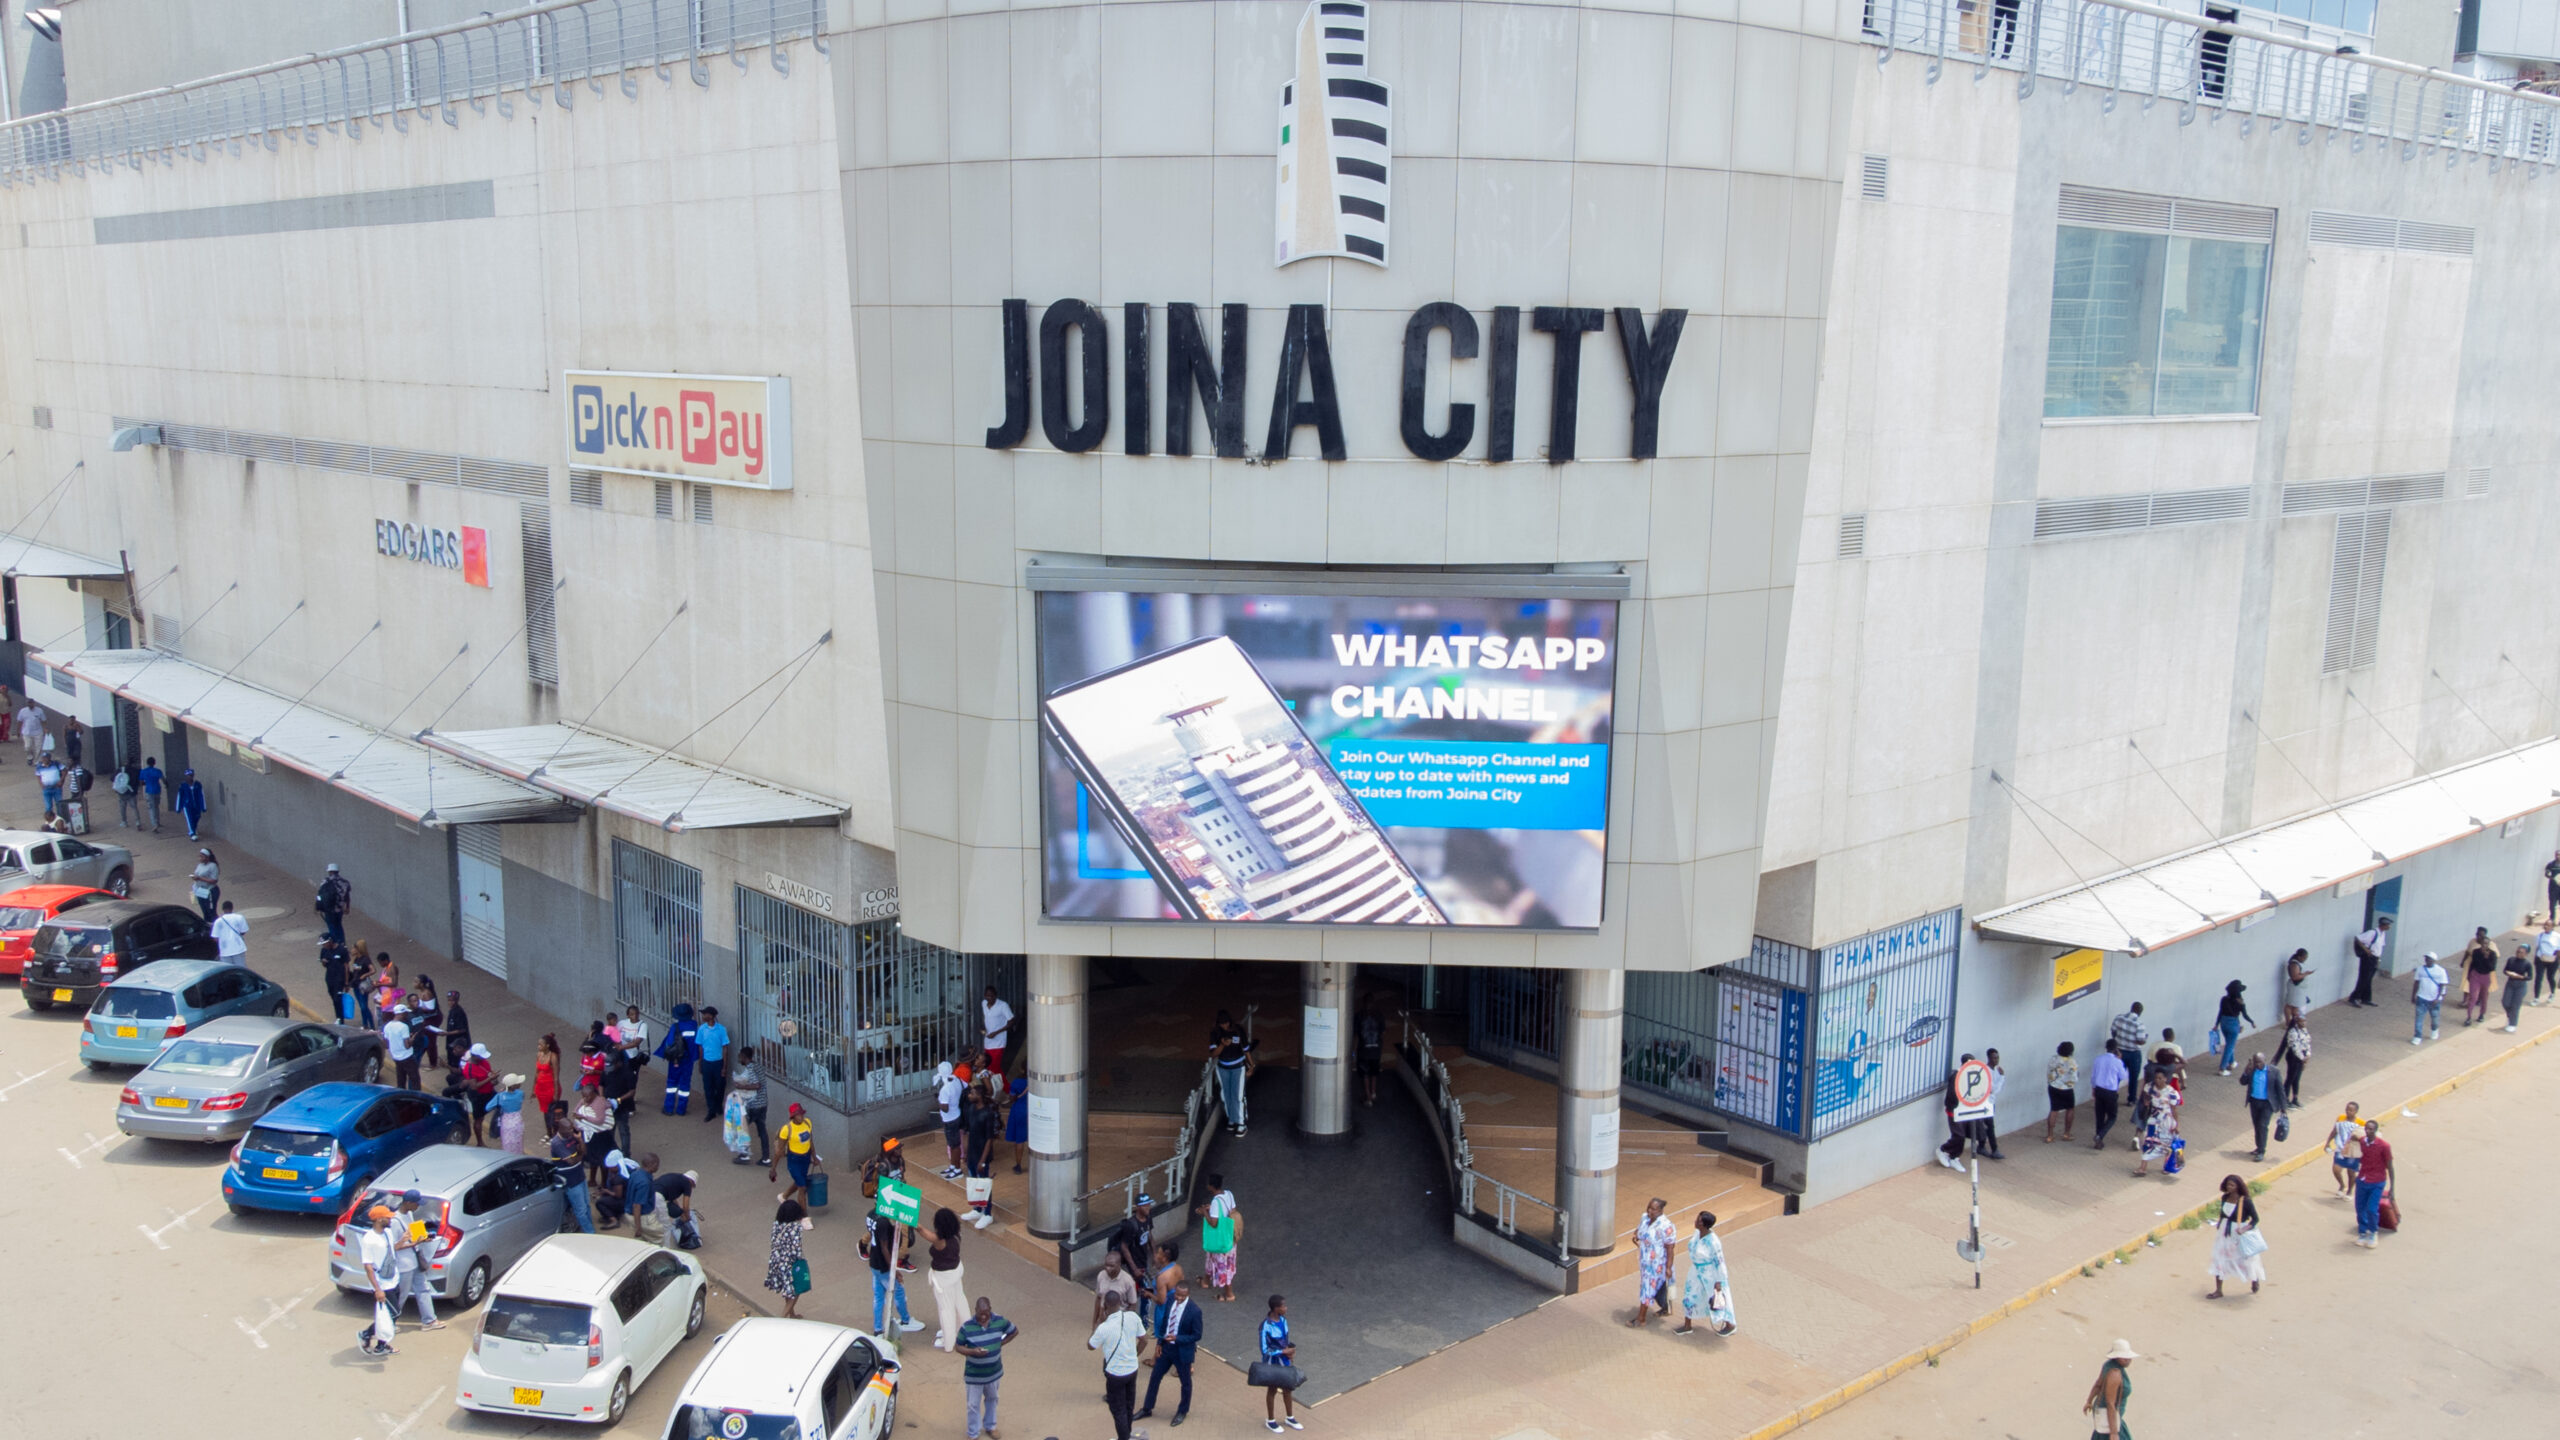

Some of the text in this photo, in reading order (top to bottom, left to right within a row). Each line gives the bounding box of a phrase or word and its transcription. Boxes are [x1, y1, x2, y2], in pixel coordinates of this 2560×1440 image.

[986, 298, 1689, 463] JOINA CITY
[573, 385, 763, 476] Pick n Pay
[375, 518, 461, 570] EDGARS
[1331, 634, 1606, 671] WHATSAPP
[1330, 685, 1558, 721] CHANNEL
[1340, 751, 1589, 768] Join Our Whatsapp Channel and
[1340, 769, 1569, 785] stay up to date with news and
[1406, 787, 1443, 799] from
[1447, 787, 1488, 801] Joina
[1491, 788, 1522, 803] City
[766, 874, 832, 912] & AWARDS
[1834, 919, 1944, 974] PHARMACY
[1785, 1003, 1799, 1119] PHARMACY
[879, 1204, 914, 1223] ONE WAY
